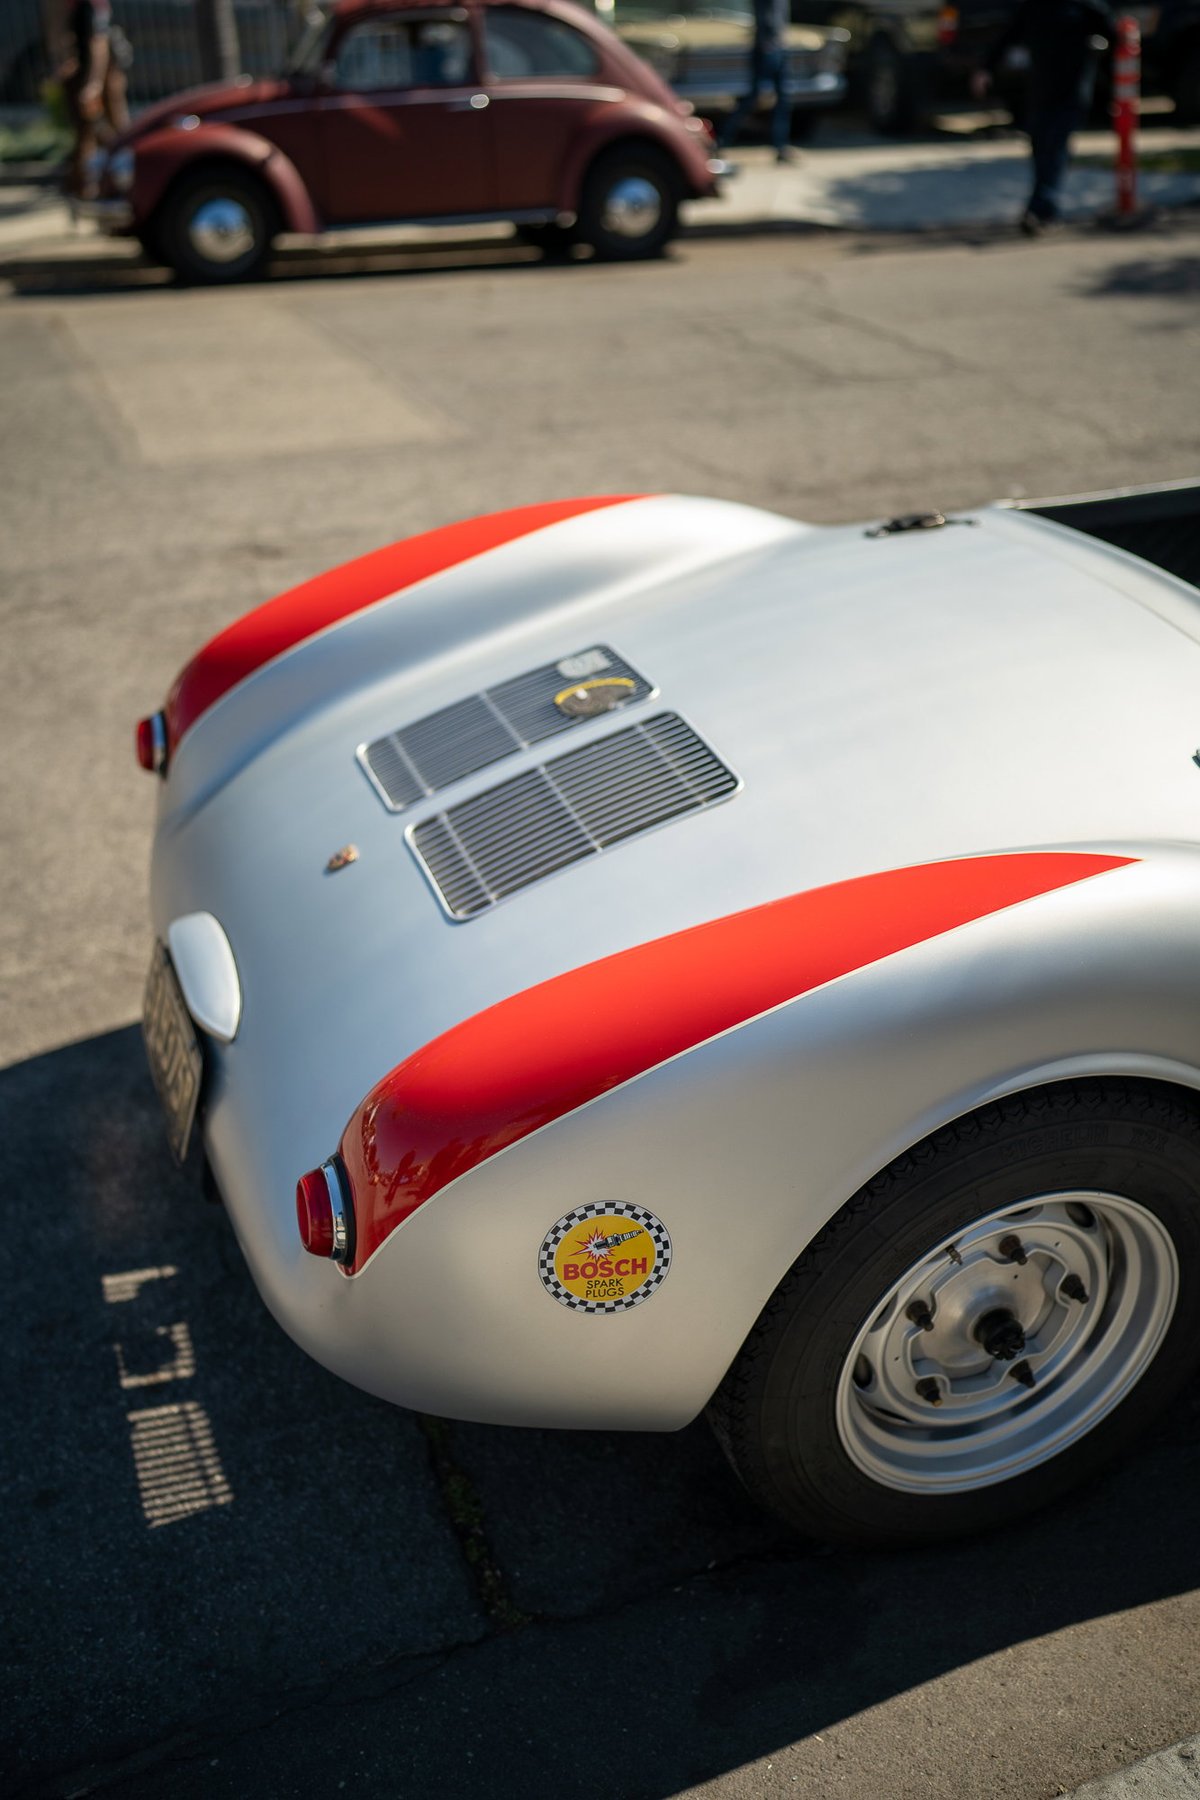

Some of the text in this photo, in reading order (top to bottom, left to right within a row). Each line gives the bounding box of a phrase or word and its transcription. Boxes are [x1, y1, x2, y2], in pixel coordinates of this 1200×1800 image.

[999, 1126, 1109, 1161] MICHELIN
[563, 1257, 647, 1280] BOSCH
[586, 1278, 623, 1289] SPARK
[585, 1287, 624, 1298] PLUGS
